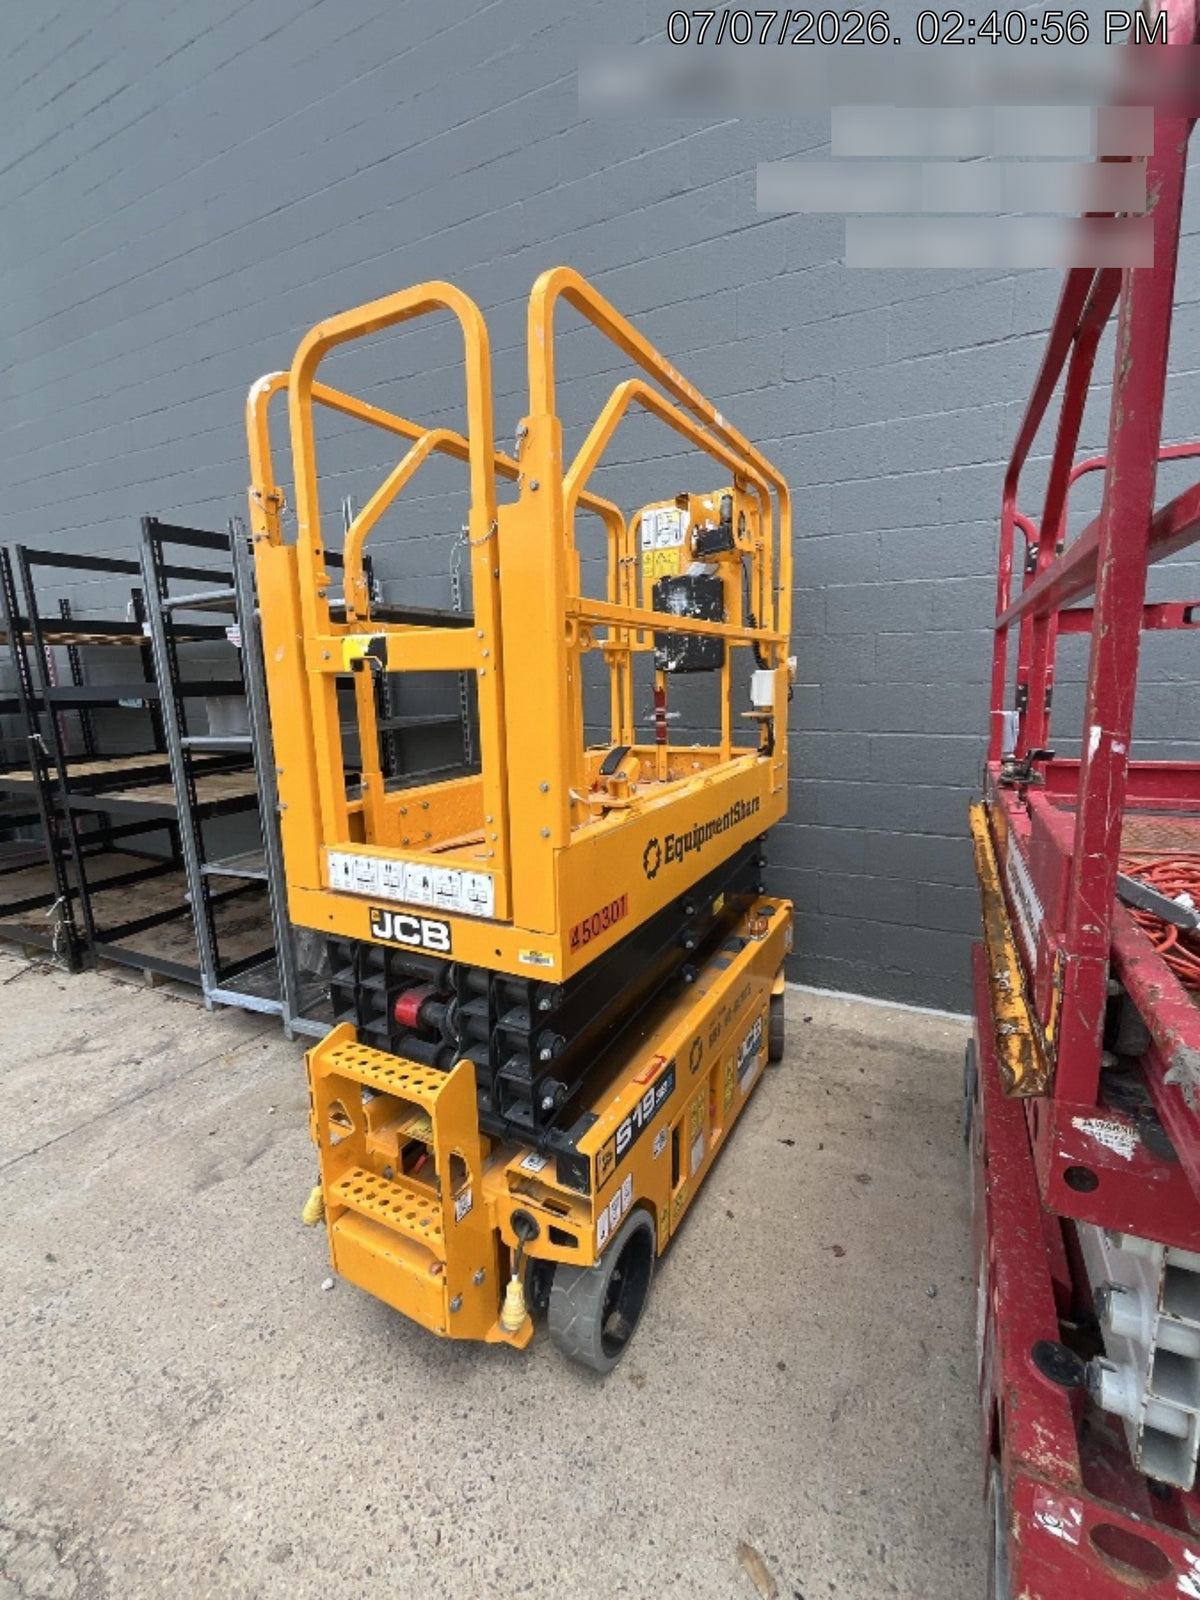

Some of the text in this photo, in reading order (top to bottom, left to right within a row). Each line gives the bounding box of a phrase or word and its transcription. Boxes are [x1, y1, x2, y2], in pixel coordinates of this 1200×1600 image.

[664, 796, 760, 864] EquipmentShare
[372, 911, 451, 951] JCB
[570, 893, 627, 949] 450301
[737, 1015, 763, 1068] JCB
